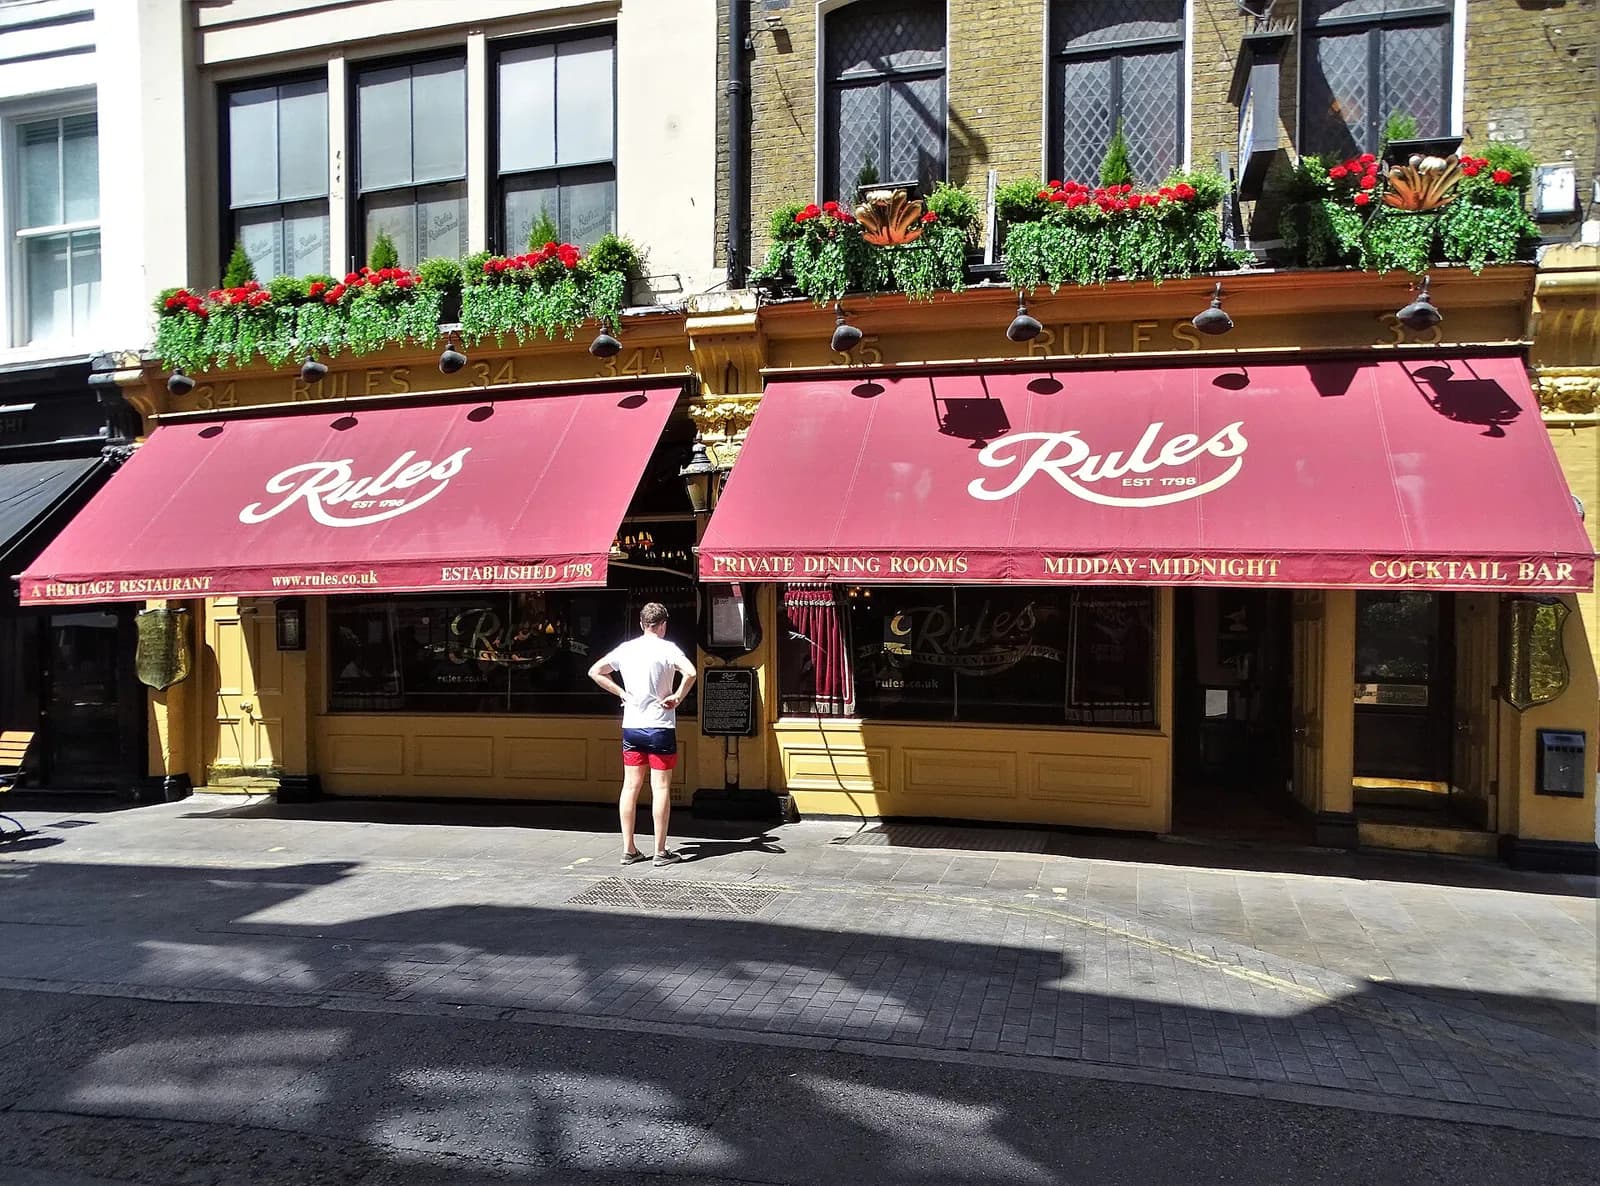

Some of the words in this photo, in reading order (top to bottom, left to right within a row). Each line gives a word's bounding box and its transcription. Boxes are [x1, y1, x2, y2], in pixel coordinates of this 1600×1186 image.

[1027, 319, 1201, 357] RULES
[470, 358, 517, 388] 34
[195, 382, 238, 410] 34
[967, 421, 1248, 508] Rules
[239, 447, 473, 528] Rules
[1122, 478, 1154, 487] EST
[1159, 476, 1197, 486] 1798
[351, 500, 377, 508] EST
[441, 565, 557, 581] ESTABLISHED
[562, 563, 593, 578] 1798
[712, 556, 796, 573] PRIVATE
[803, 556, 881, 573] DINING
[890, 556, 969, 573] ROOMS
[1043, 557, 1281, 577] MIDDAY-MIDNIGHT
[1369, 560, 1508, 581] COCKTAIL
[1518, 562, 1576, 581] BAR
[31, 583, 42, 598] A
[46, 579, 115, 597] HERITAGE
[119, 576, 213, 593] RESTAURANT
[271, 569, 379, 588] www.rules.co.uk
